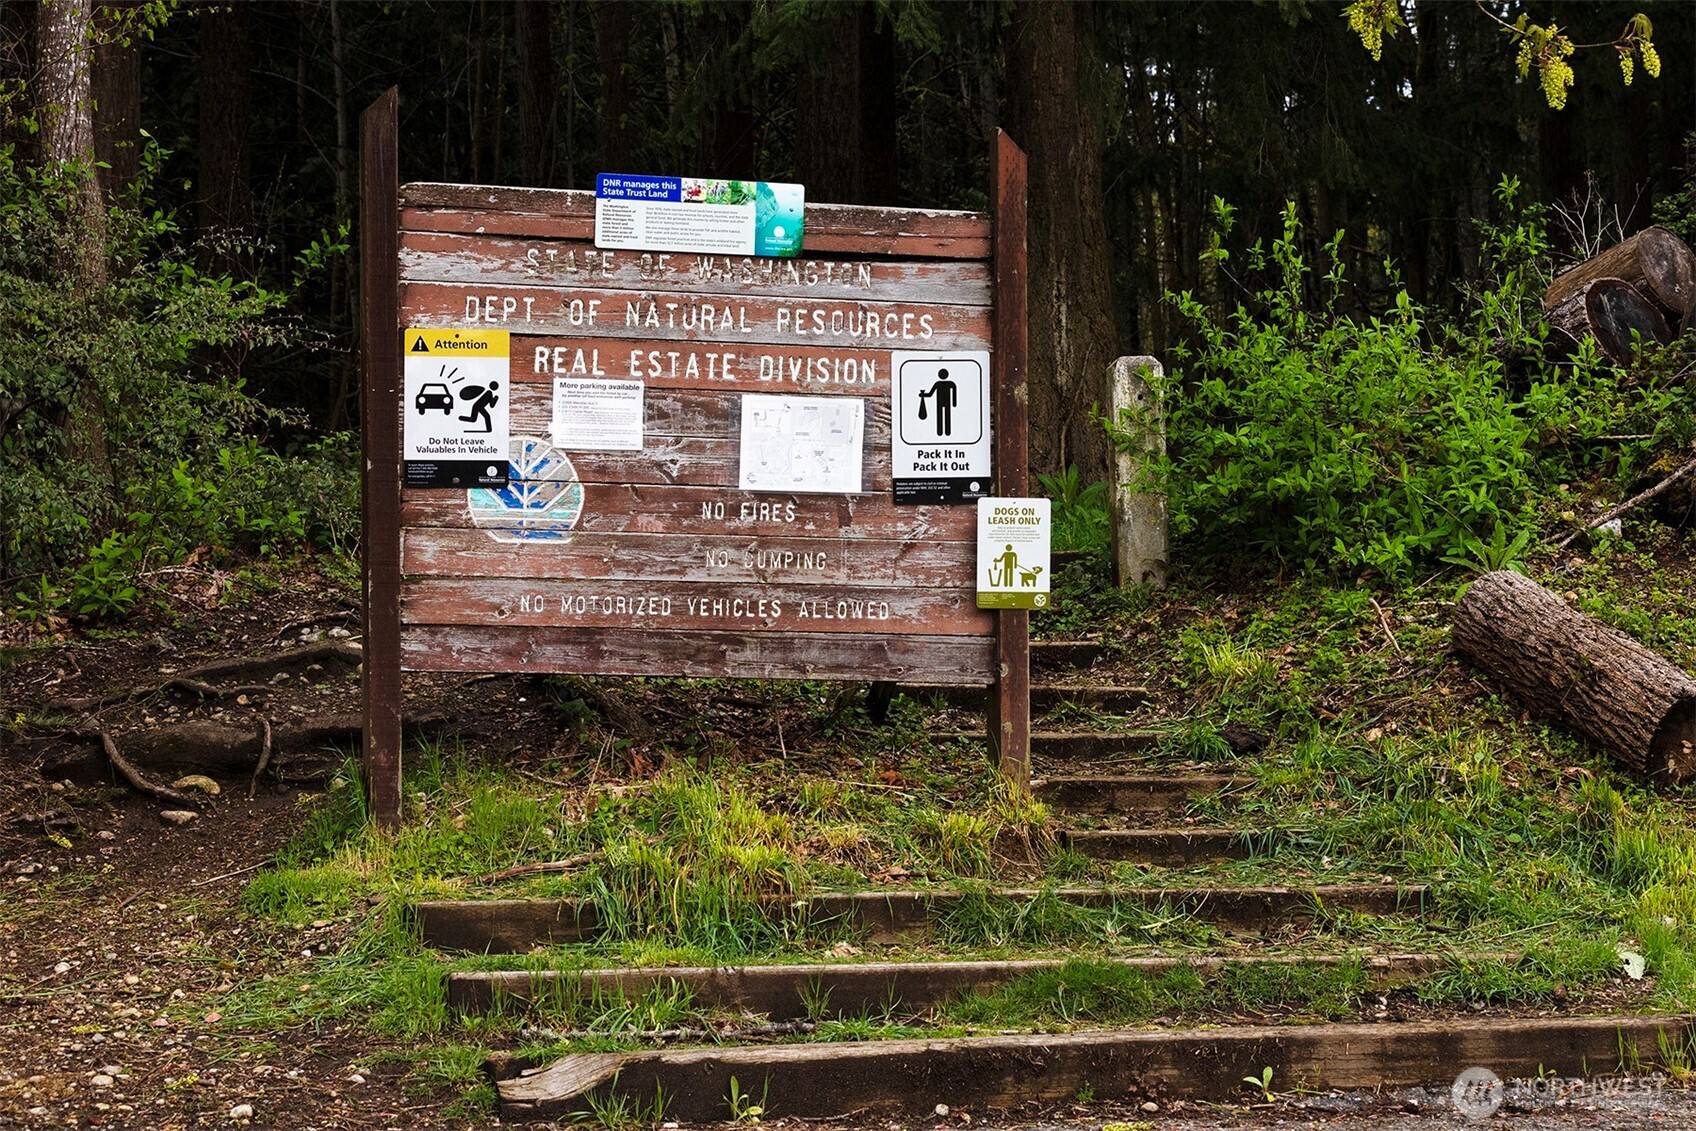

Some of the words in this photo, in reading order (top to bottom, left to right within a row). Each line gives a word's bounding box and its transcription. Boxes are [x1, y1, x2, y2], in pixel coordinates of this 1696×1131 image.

[623, 181, 659, 190] manages
[662, 182, 676, 190] this
[527, 248, 615, 278] STATE
[640, 253, 670, 280] OF
[697, 256, 872, 289] WASHINGTON
[466, 296, 545, 324] DEPT.
[570, 299, 602, 326] OF
[626, 301, 752, 333] NATURAL
[776, 308, 933, 339] RESOURCES
[434, 340, 488, 350] Attention
[534, 346, 605, 376] REAL
[630, 350, 736, 381] ESTATE
[760, 355, 876, 384] DIVISION
[918, 449, 940, 459] Pack
[945, 450, 952, 458] It
[956, 450, 965, 458] In
[913, 462, 937, 471] Pack
[940, 462, 948, 471] It
[951, 462, 970, 471] Out
[702, 501, 724, 520] NO
[740, 502, 796, 522] FIRES
[706, 550, 728, 568] NO
[744, 550, 827, 570] DUMPING
[520, 595, 544, 613] NO
[561, 595, 671, 615] MOTORIZED
[687, 598, 782, 618] VEHICLES
[799, 600, 890, 620] ALLOWED
